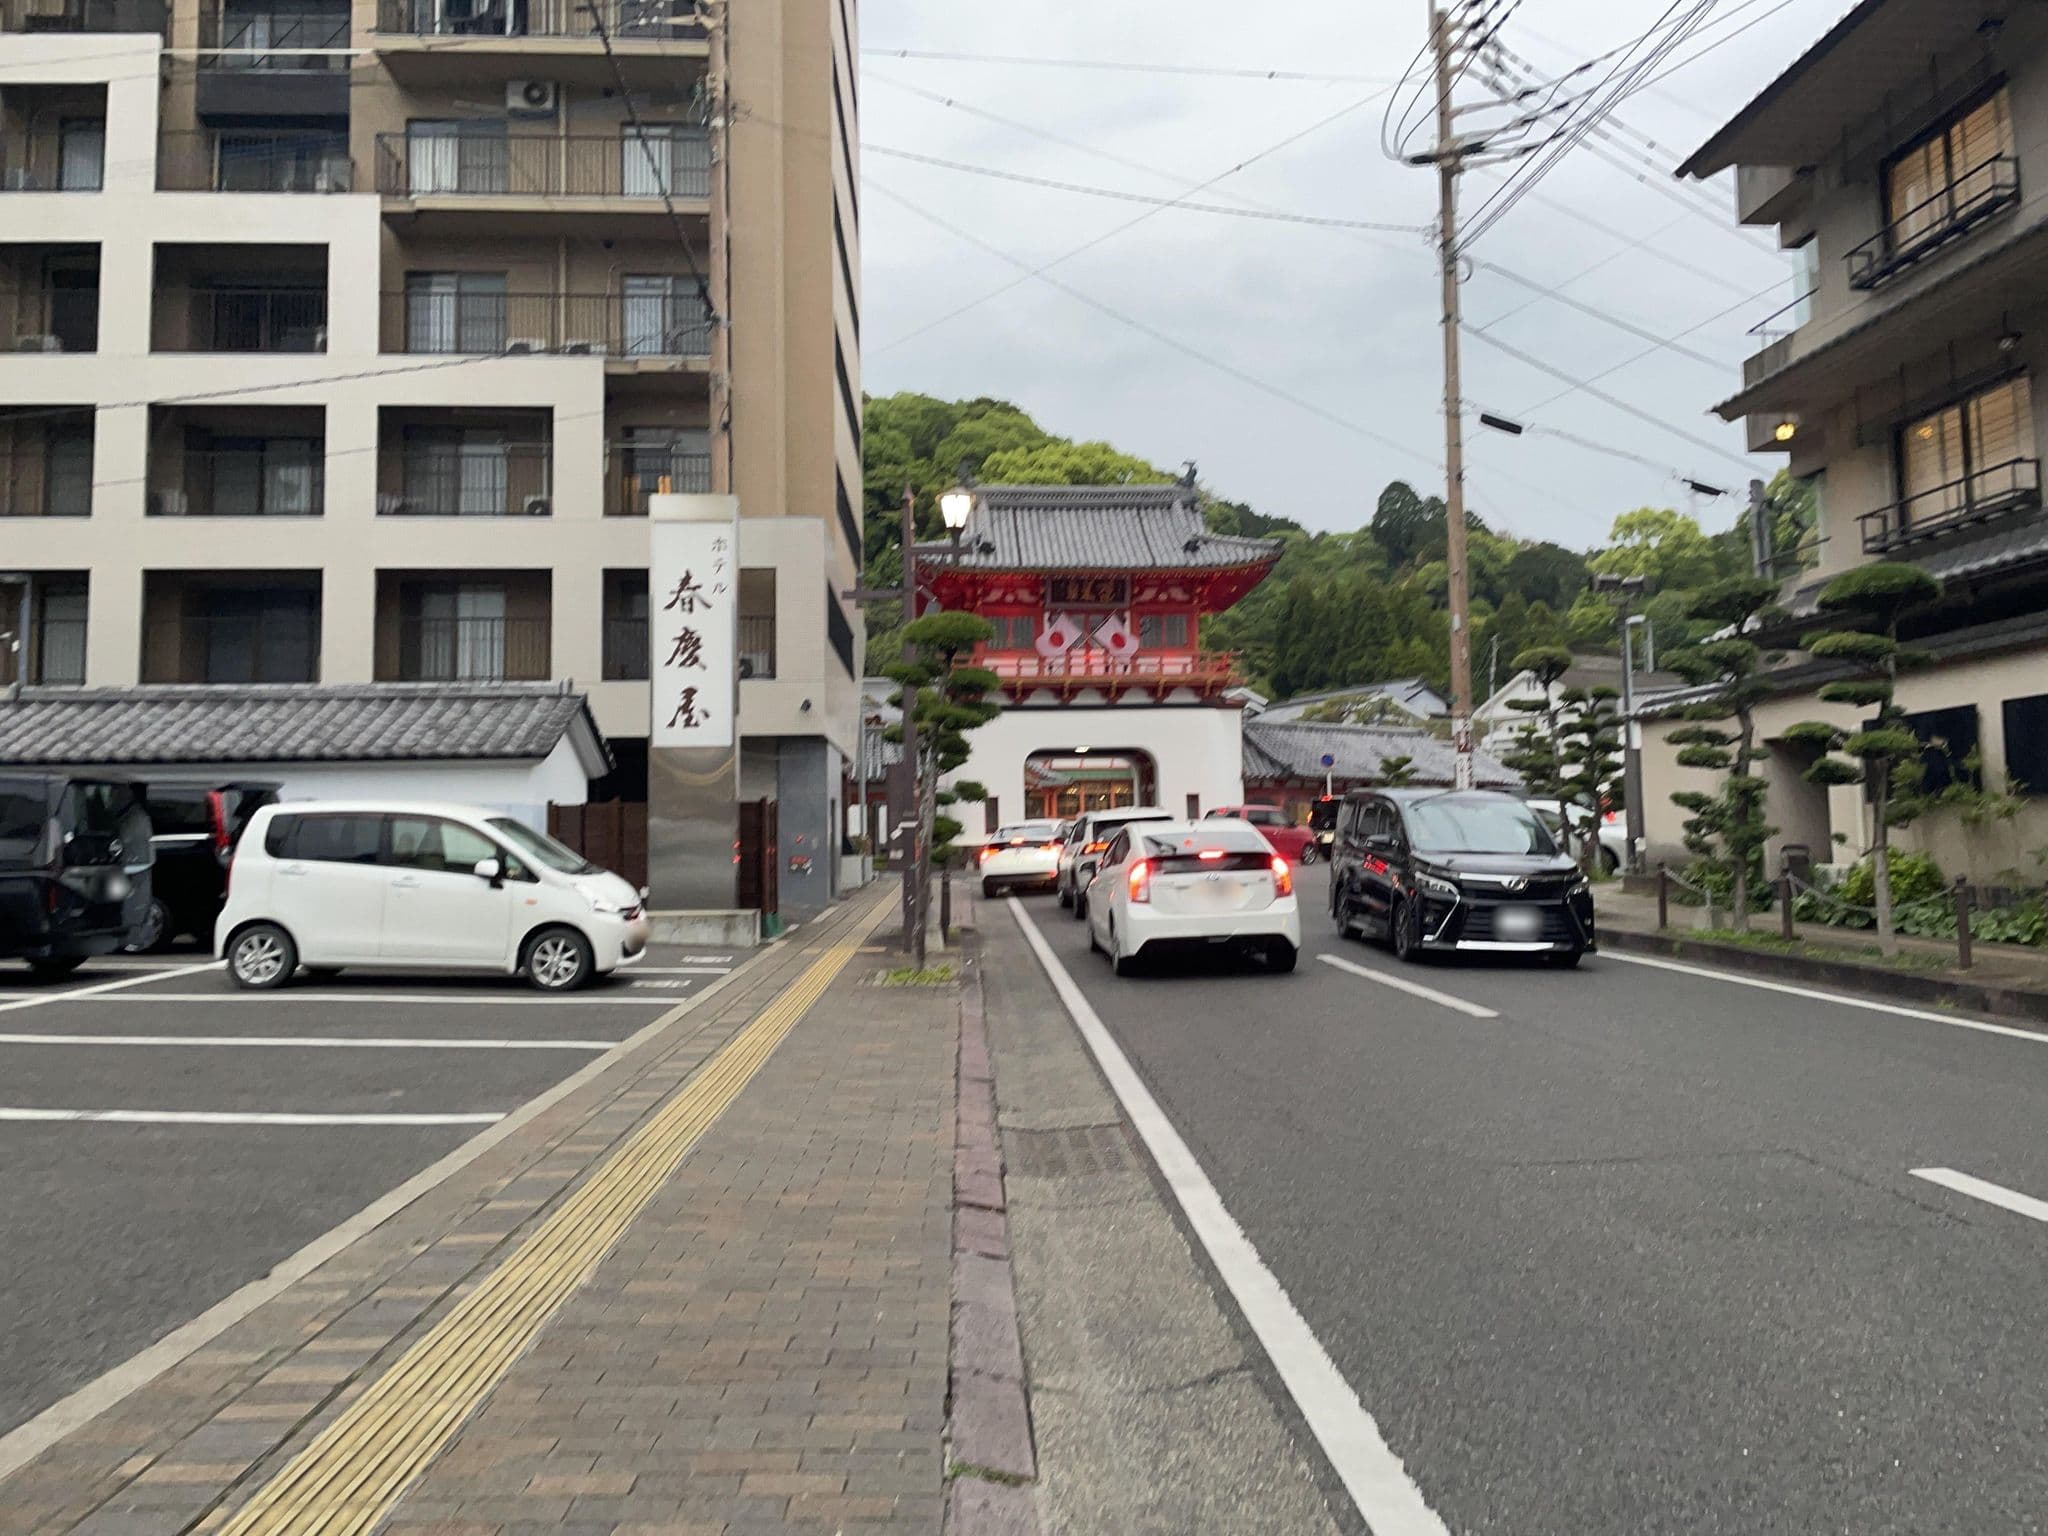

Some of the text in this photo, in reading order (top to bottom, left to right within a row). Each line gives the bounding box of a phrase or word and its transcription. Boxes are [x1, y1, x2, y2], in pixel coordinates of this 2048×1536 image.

[711, 535, 728, 595] ホテル
[663, 568, 713, 730] 春慶屋
